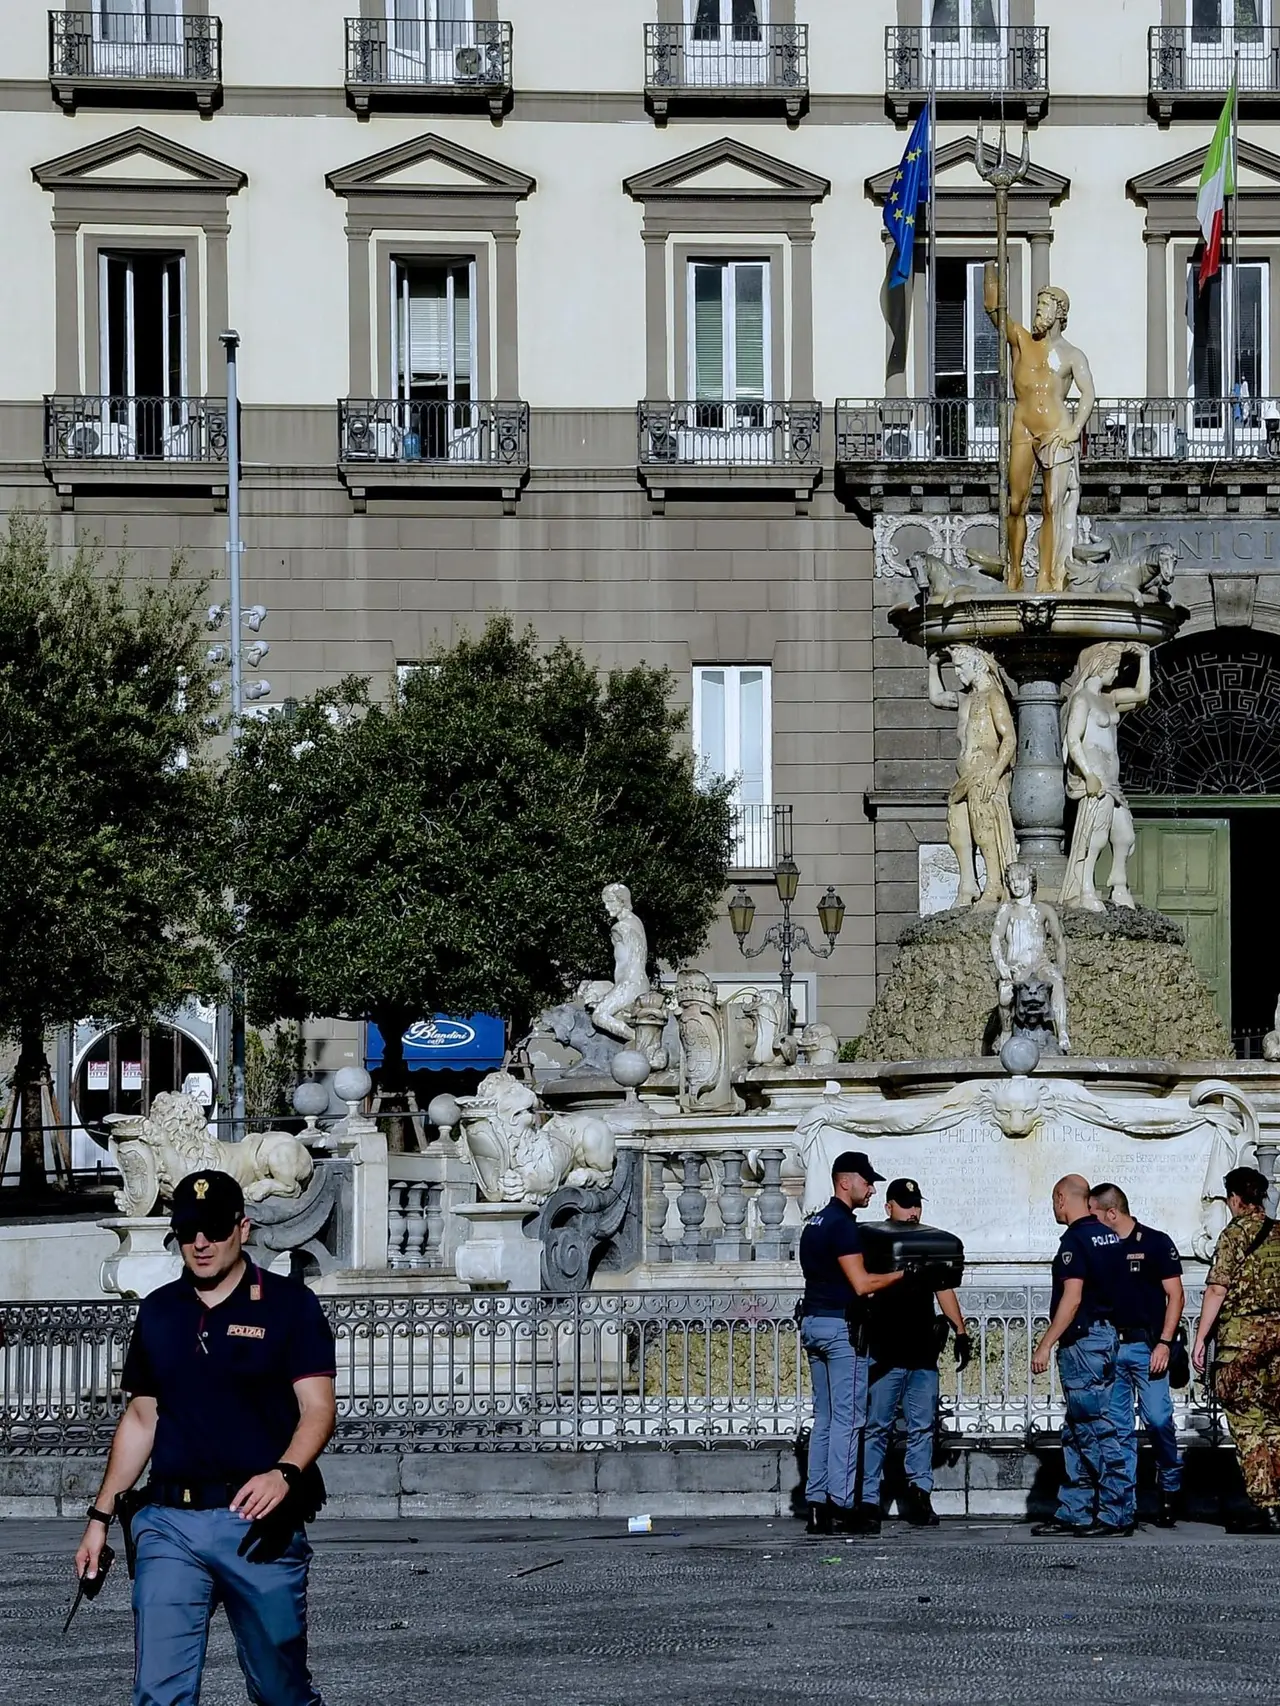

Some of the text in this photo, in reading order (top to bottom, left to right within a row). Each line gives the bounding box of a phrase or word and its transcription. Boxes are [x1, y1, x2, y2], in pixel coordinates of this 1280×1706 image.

[405, 1022, 467, 1040] Blandini
[939, 1128, 1004, 1144] PHILIPPO
[1062, 1124, 1100, 1142] REGE
[229, 1326, 263, 1337] POLIZIA
